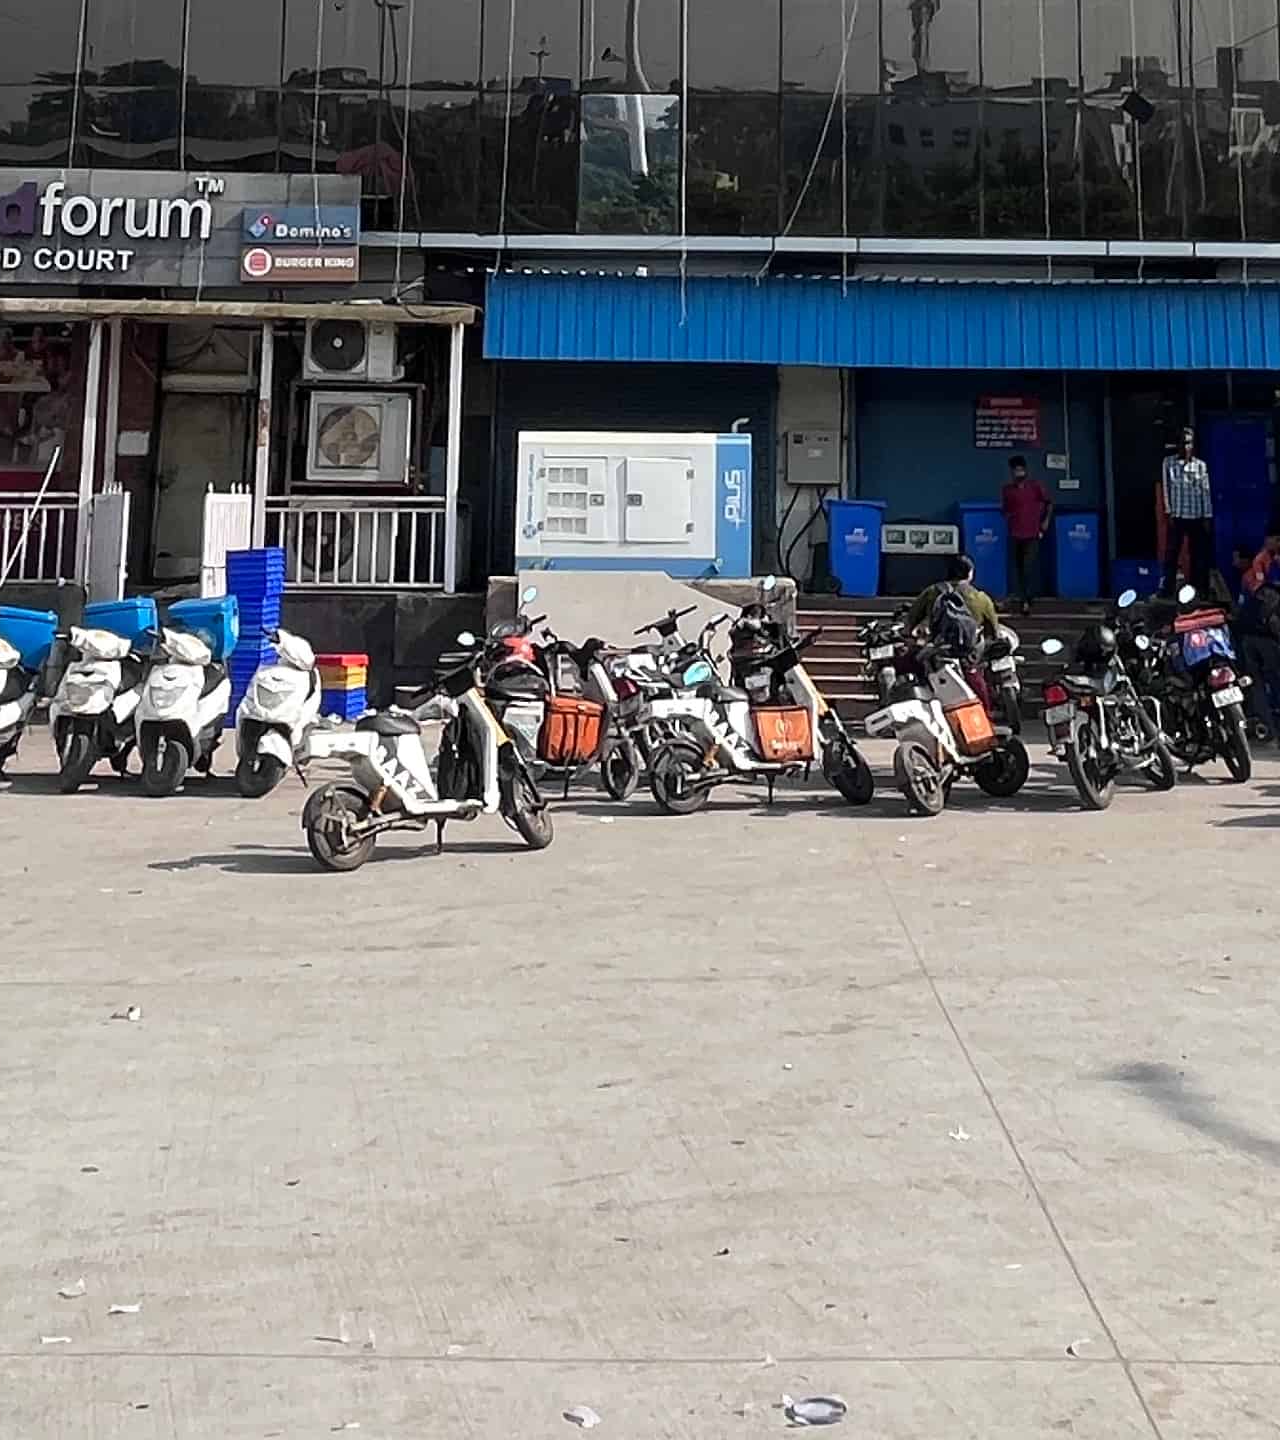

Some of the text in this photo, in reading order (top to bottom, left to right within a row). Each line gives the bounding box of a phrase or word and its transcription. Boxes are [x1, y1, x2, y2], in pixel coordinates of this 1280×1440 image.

[275, 223, 352, 238] Domino's
[33, 247, 133, 271] COURT
[274, 257, 322, 268] BURGER
